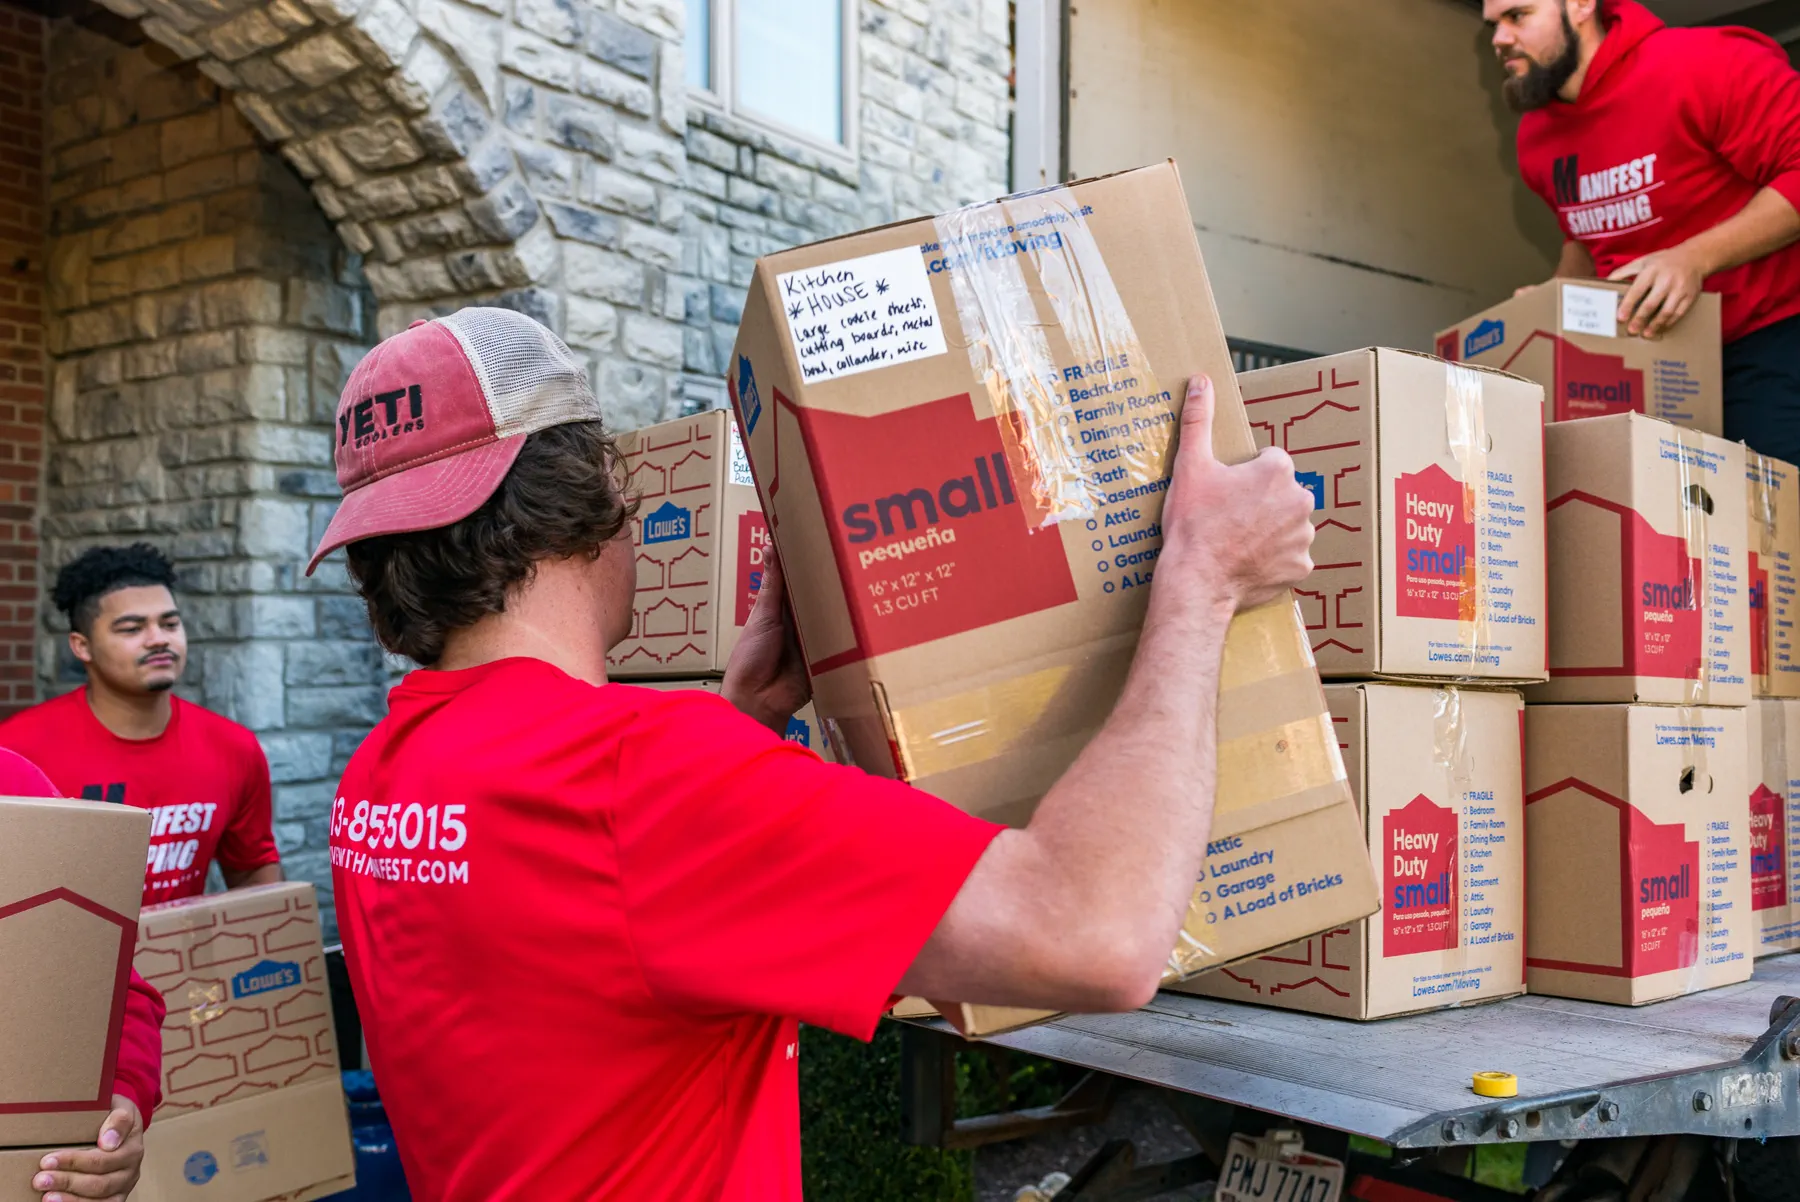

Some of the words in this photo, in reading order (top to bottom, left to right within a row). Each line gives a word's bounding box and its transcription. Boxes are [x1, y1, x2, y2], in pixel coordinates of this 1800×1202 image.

[1553, 153, 1657, 204] MANIFEST
[1567, 194, 1653, 235] SHIPPING
[919, 242, 940, 254] ake
[1000, 226, 1015, 238] go
[784, 270, 855, 297] Kitchen
[795, 323, 830, 343] Large
[800, 337, 845, 358] cutting
[902, 315, 934, 333] metal
[836, 348, 894, 371] collander,
[897, 340, 928, 356] misc
[1063, 354, 1130, 382] FRAGILE
[1069, 377, 1138, 403] Bedroom
[1568, 380, 1631, 403] small
[339, 384, 422, 447] YETI
[1074, 401, 1125, 424] Family
[1127, 390, 1172, 410] Room
[1080, 424, 1131, 445] Dining
[1132, 411, 1176, 431] Room
[1086, 442, 1146, 463] Kitchen
[1092, 466, 1129, 485] Bath
[1487, 471, 1513, 484] FRAGILE
[842, 452, 1016, 544] small
[1487, 485, 1515, 497] Bedroom
[1406, 492, 1454, 524] Heavy
[1488, 499, 1508, 512] Family
[1508, 502, 1525, 513] Room
[648, 516, 687, 539] LOWE'S
[1104, 508, 1141, 528] Attic
[1488, 513, 1507, 526] Dining
[1508, 516, 1525, 527] Room
[1108, 523, 1162, 548] Laundr
[1406, 518, 1442, 548] Duty
[1487, 528, 1512, 539] Kitchen
[858, 527, 957, 570] pequeña
[1488, 542, 1503, 552] Bath
[1407, 545, 1466, 576] small
[1488, 556, 1519, 568] Basement
[868, 580, 889, 597] 16"
[891, 580, 900, 591] x
[901, 572, 921, 588] 12"
[925, 571, 934, 582] x
[936, 562, 956, 579] 12"
[1121, 575, 1134, 590] A
[1134, 572, 1153, 586] Lo
[1488, 570, 1503, 580] Attic
[873, 600, 894, 617] 1.3
[895, 592, 919, 611] CU
[921, 587, 940, 604] FT
[1488, 585, 1514, 597] Laundry
[1642, 578, 1694, 610] small
[1488, 600, 1512, 611] Garage
[1644, 610, 1674, 624] pequeña
[1494, 613, 1510, 623] Load
[1517, 615, 1536, 626] Bricks
[1469, 791, 1494, 801] FRAGILE
[1469, 806, 1495, 815] Bedroom
[1469, 820, 1488, 830] Family
[1489, 820, 1505, 829] Room
[1206, 835, 1244, 858] Attic
[1393, 828, 1439, 853] Heavy
[1469, 834, 1488, 845] Dining
[1489, 833, 1505, 843] Room
[1210, 849, 1274, 879] Laundry
[1470, 848, 1492, 858] Kitchen
[1393, 855, 1428, 880] Duty
[1470, 864, 1484, 873] Bath
[1216, 873, 1276, 899] Garage
[1393, 872, 1450, 909] small
[1470, 877, 1499, 887] Basement
[1640, 864, 1690, 903] small
[1223, 905, 1236, 921] A
[1236, 891, 1277, 916] Load
[1279, 884, 1294, 903] of
[1297, 873, 1344, 897] Bricks
[1470, 892, 1484, 901] Attic
[1393, 912, 1404, 921] Para
[1470, 905, 1494, 916] Laundry
[1641, 903, 1671, 920] pequeña
[1470, 921, 1492, 931] Garage
[1475, 935, 1490, 944] Load
[1497, 932, 1515, 942] Bricks
[240, 969, 295, 994] LOWE'S
[1413, 977, 1480, 997] Lowes.com/Moving
[1225, 1153, 1270, 1197] PMJ
